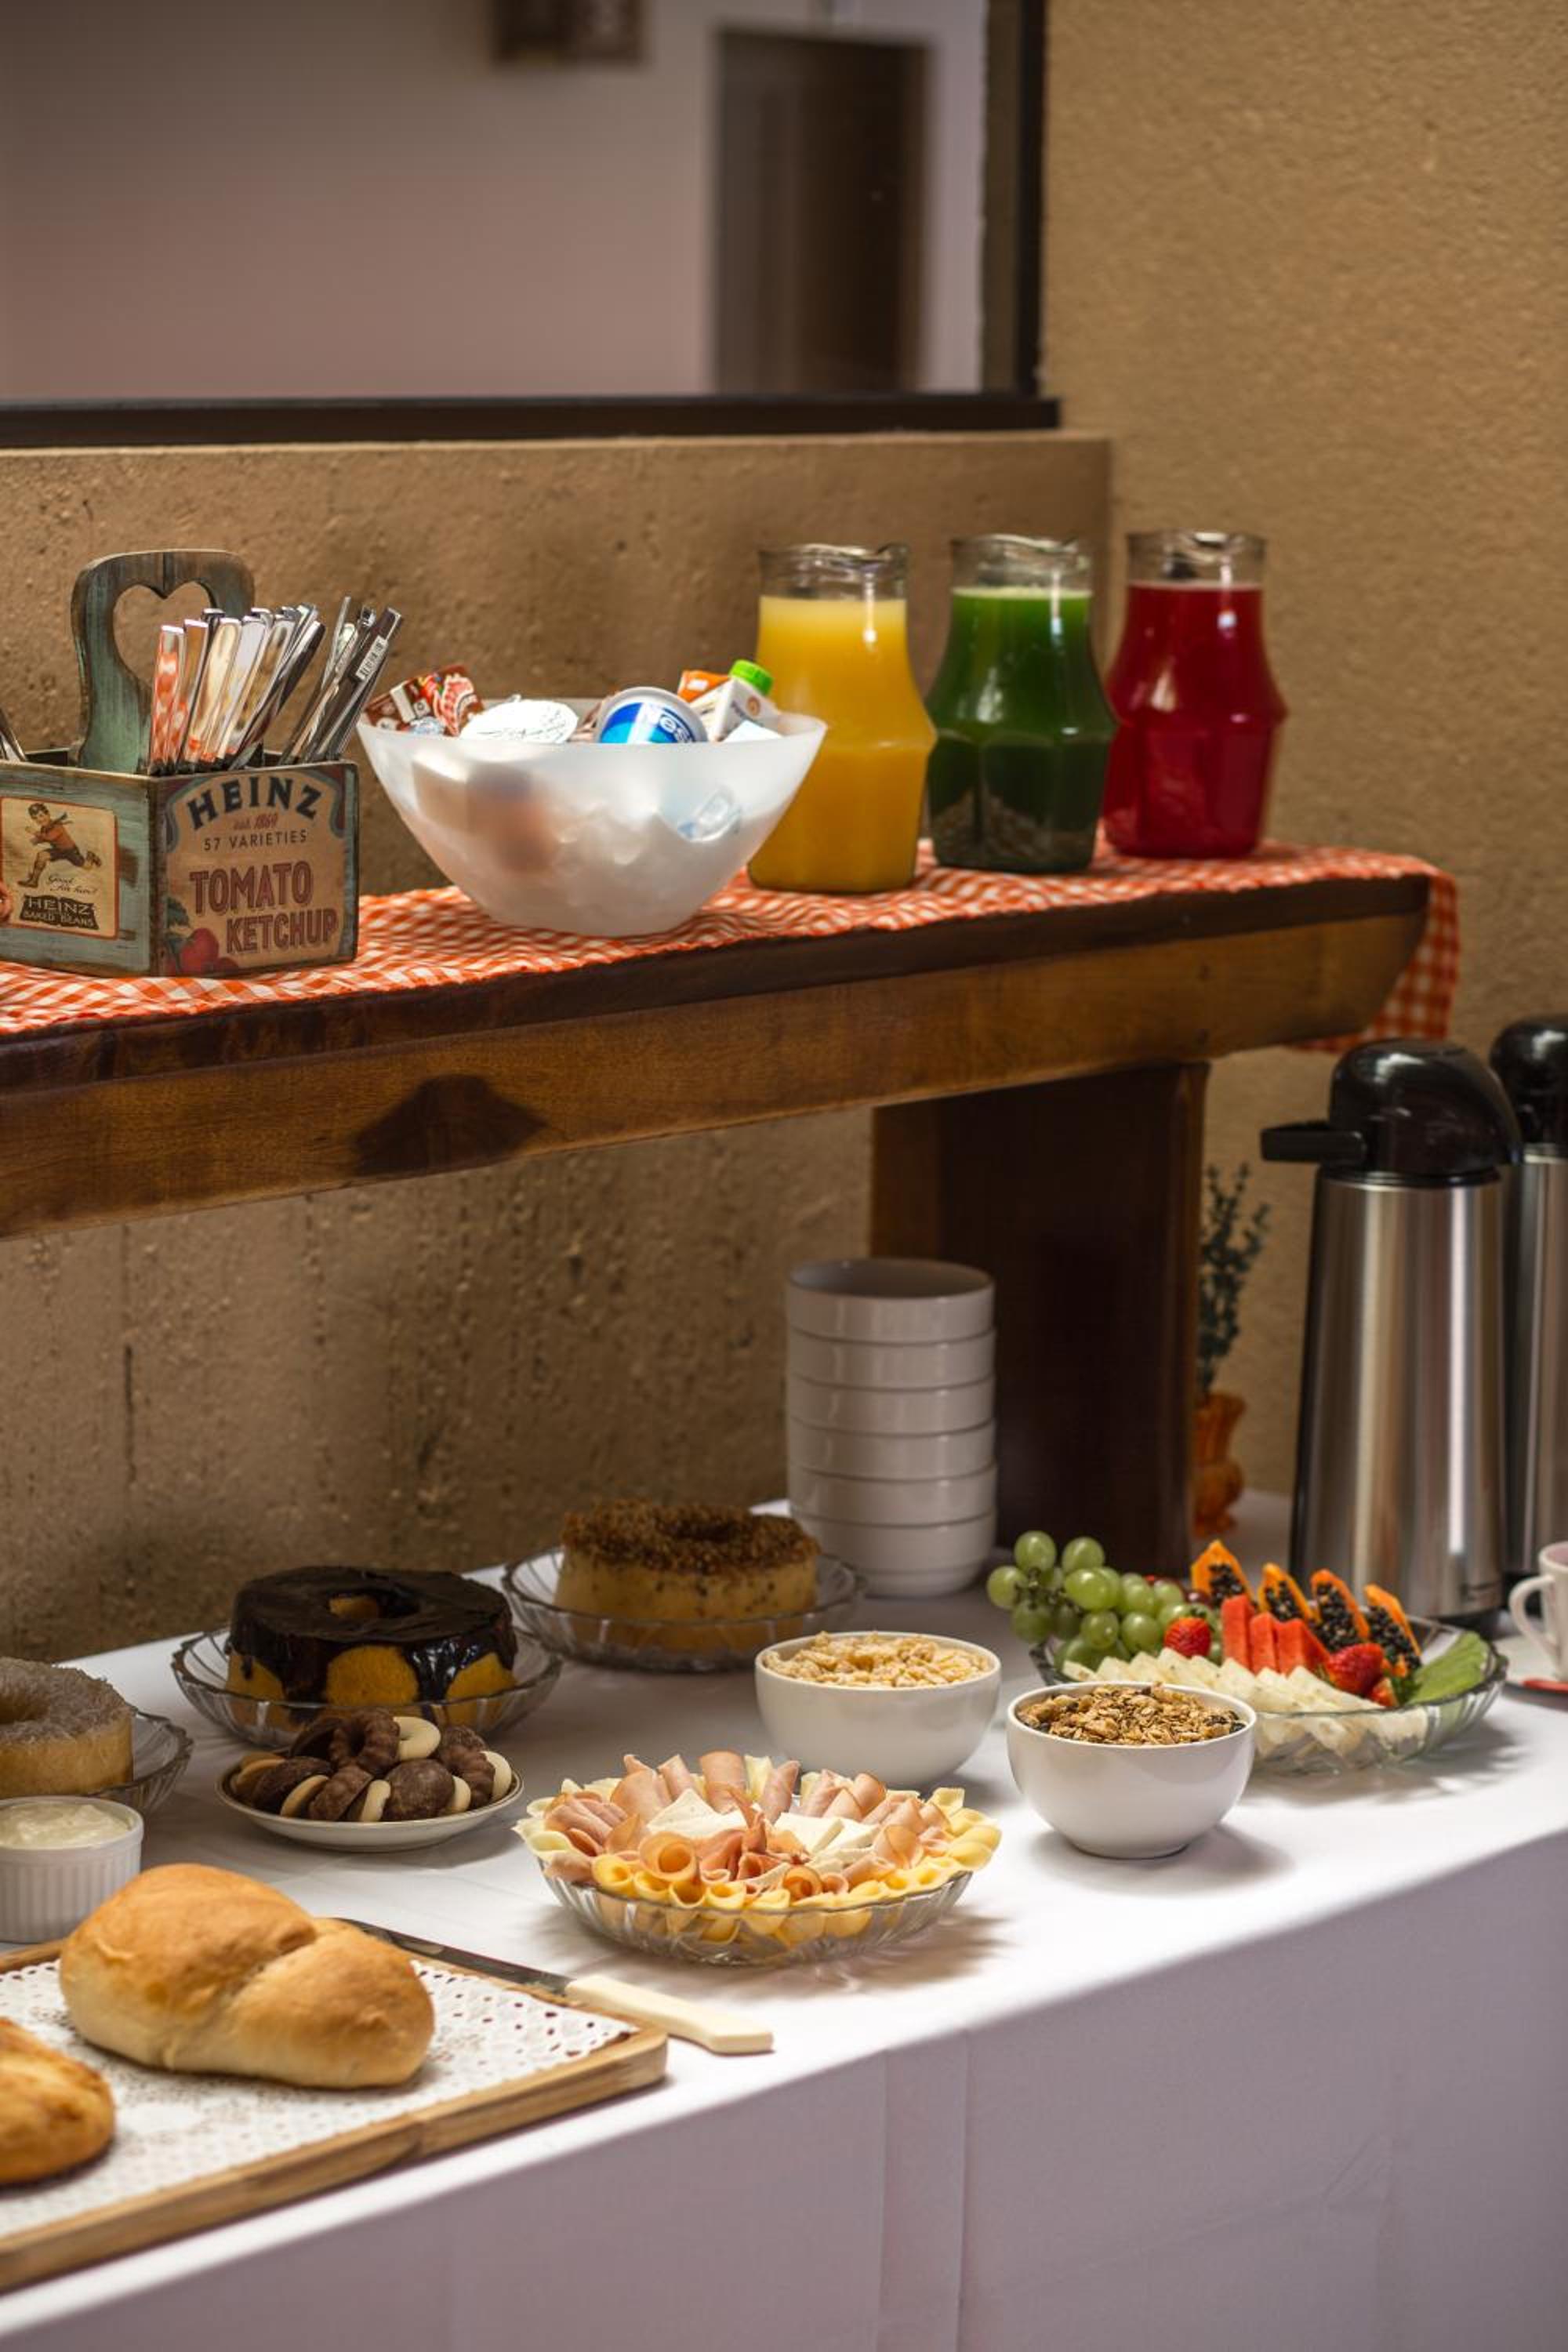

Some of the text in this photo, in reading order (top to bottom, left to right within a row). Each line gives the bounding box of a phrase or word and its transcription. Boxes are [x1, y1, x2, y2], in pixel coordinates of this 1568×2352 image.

[187, 775, 322, 831] HEINZ
[204, 829, 308, 851] 57 VARIETIES
[189, 860, 312, 916] TOMATO
[23, 910, 94, 927] BAKED BEANS
[27, 897, 91, 916] HEINZ
[226, 907, 338, 954] KETCHUP
